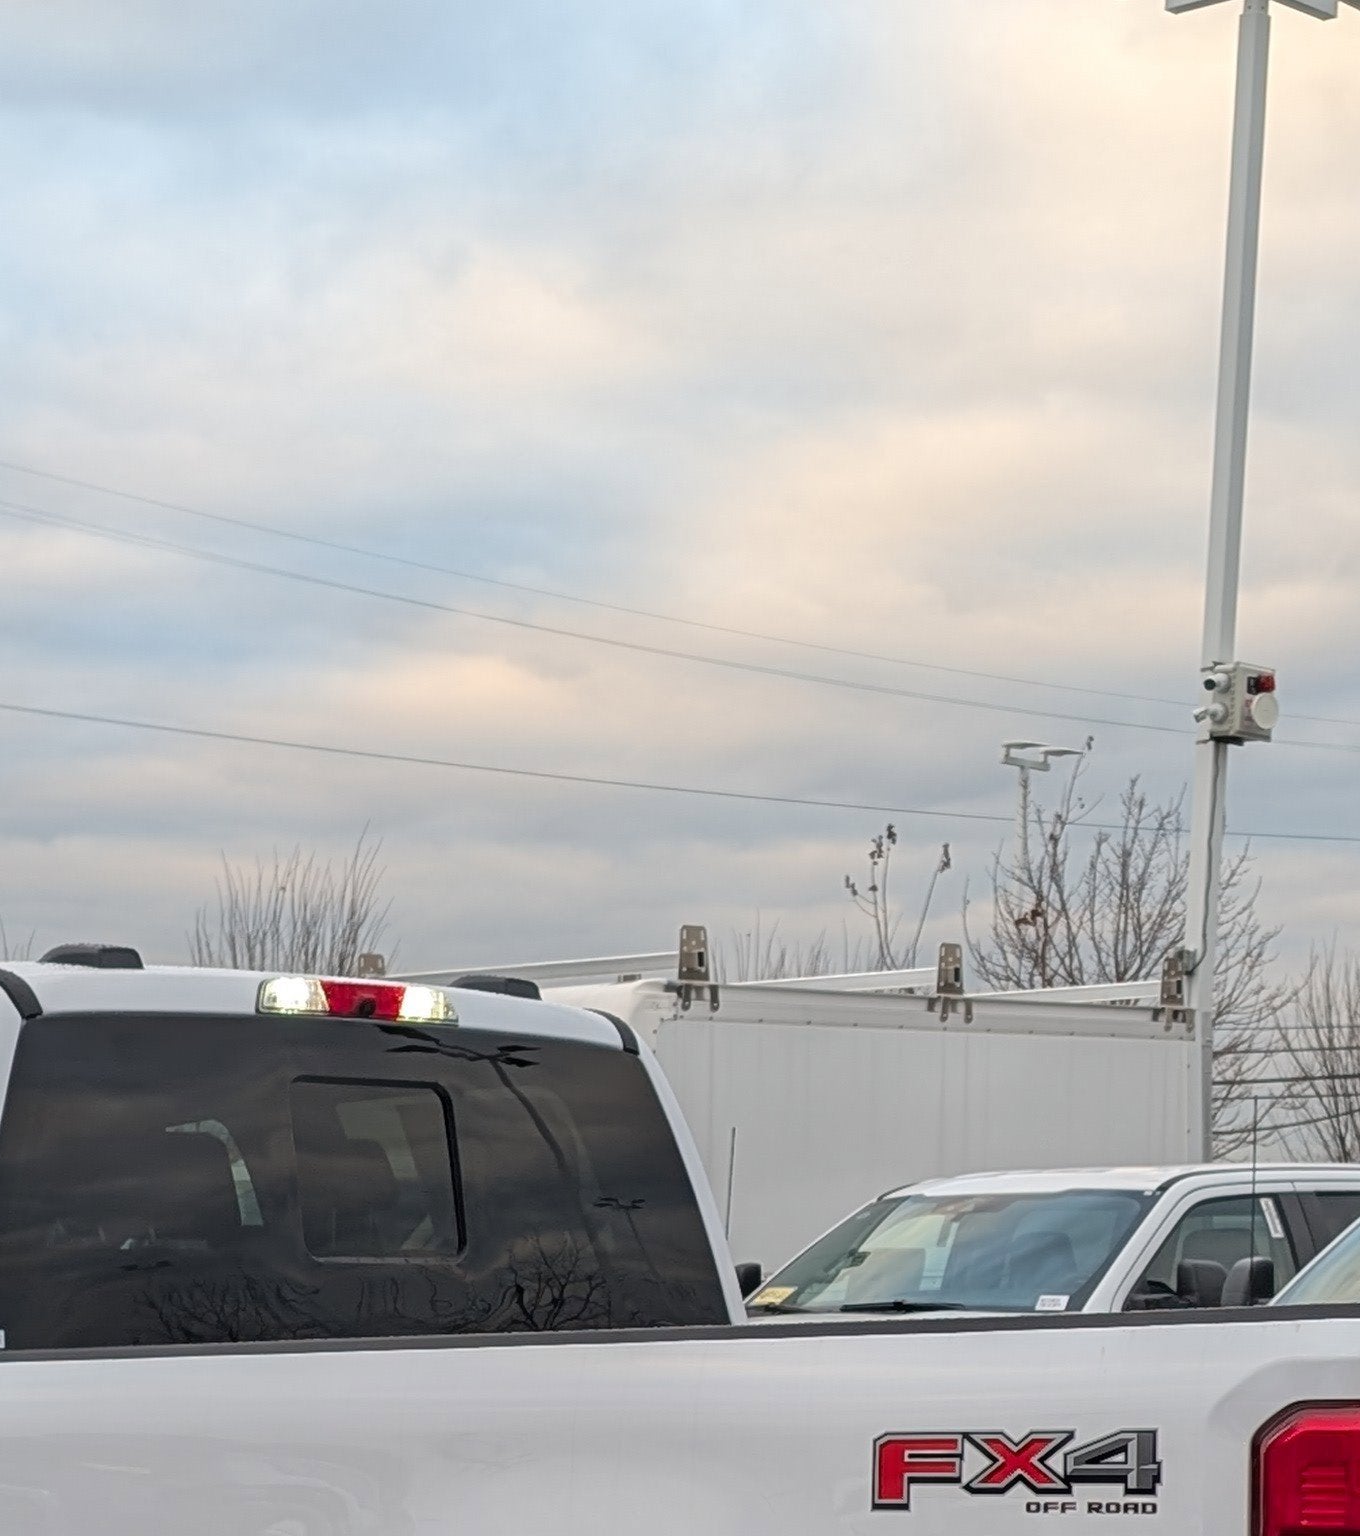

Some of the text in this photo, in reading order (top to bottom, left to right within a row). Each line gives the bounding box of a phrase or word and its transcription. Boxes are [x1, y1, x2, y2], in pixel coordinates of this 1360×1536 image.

[871, 1430, 1161, 1511] FX4
[1025, 1501, 1158, 1515] OFF ROAD
